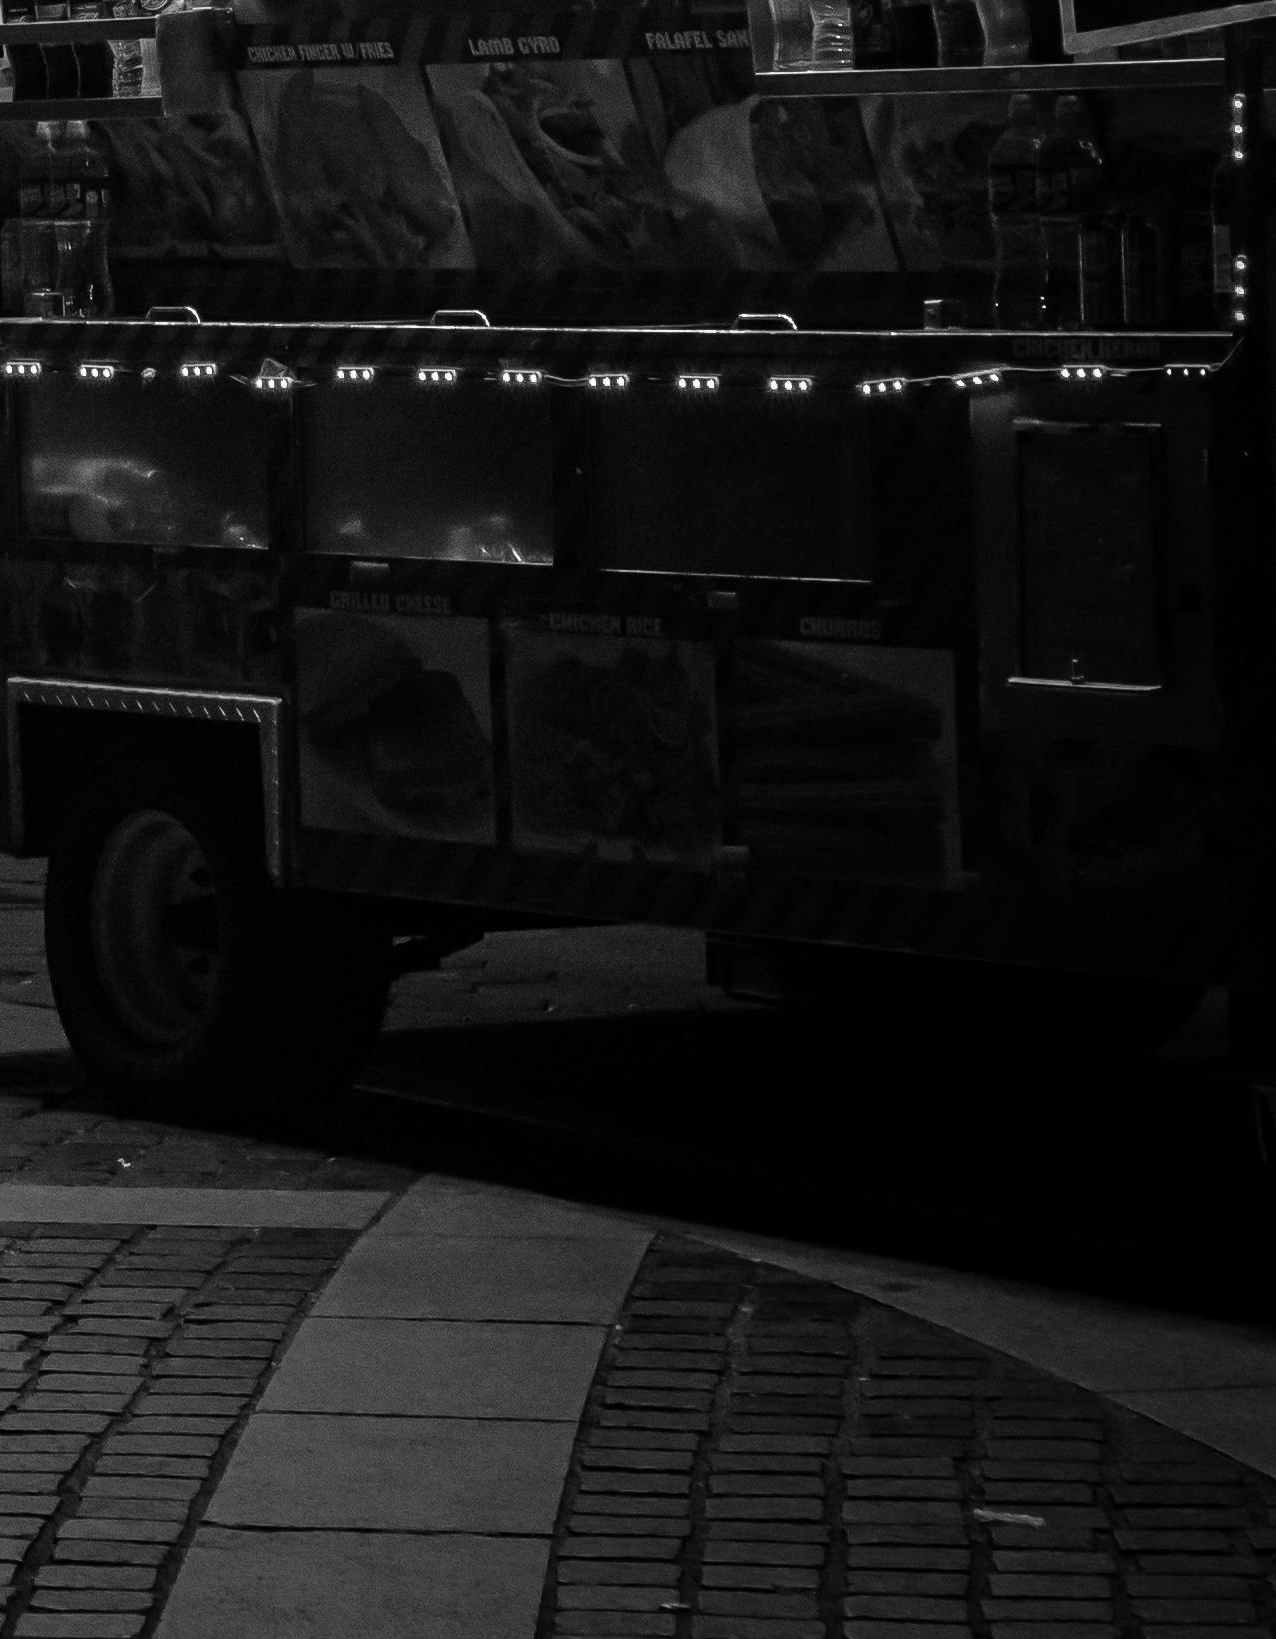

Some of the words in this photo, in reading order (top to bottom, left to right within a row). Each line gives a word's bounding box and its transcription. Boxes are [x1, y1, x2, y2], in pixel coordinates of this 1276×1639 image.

[467, 37, 514, 57] LAMB
[517, 35, 561, 55] GYRO
[644, 30, 714, 50] FALAFEL
[715, 29, 750, 48] SAN
[247, 45, 297, 62] CHICKEN
[298, 44, 340, 60] FINGER
[328, 590, 390, 612] GRILLED
[396, 593, 452, 615] CHEESE
[548, 612, 621, 633] CHICKEN
[624, 614, 664, 637] RICE
[799, 615, 883, 641] CHURROS
